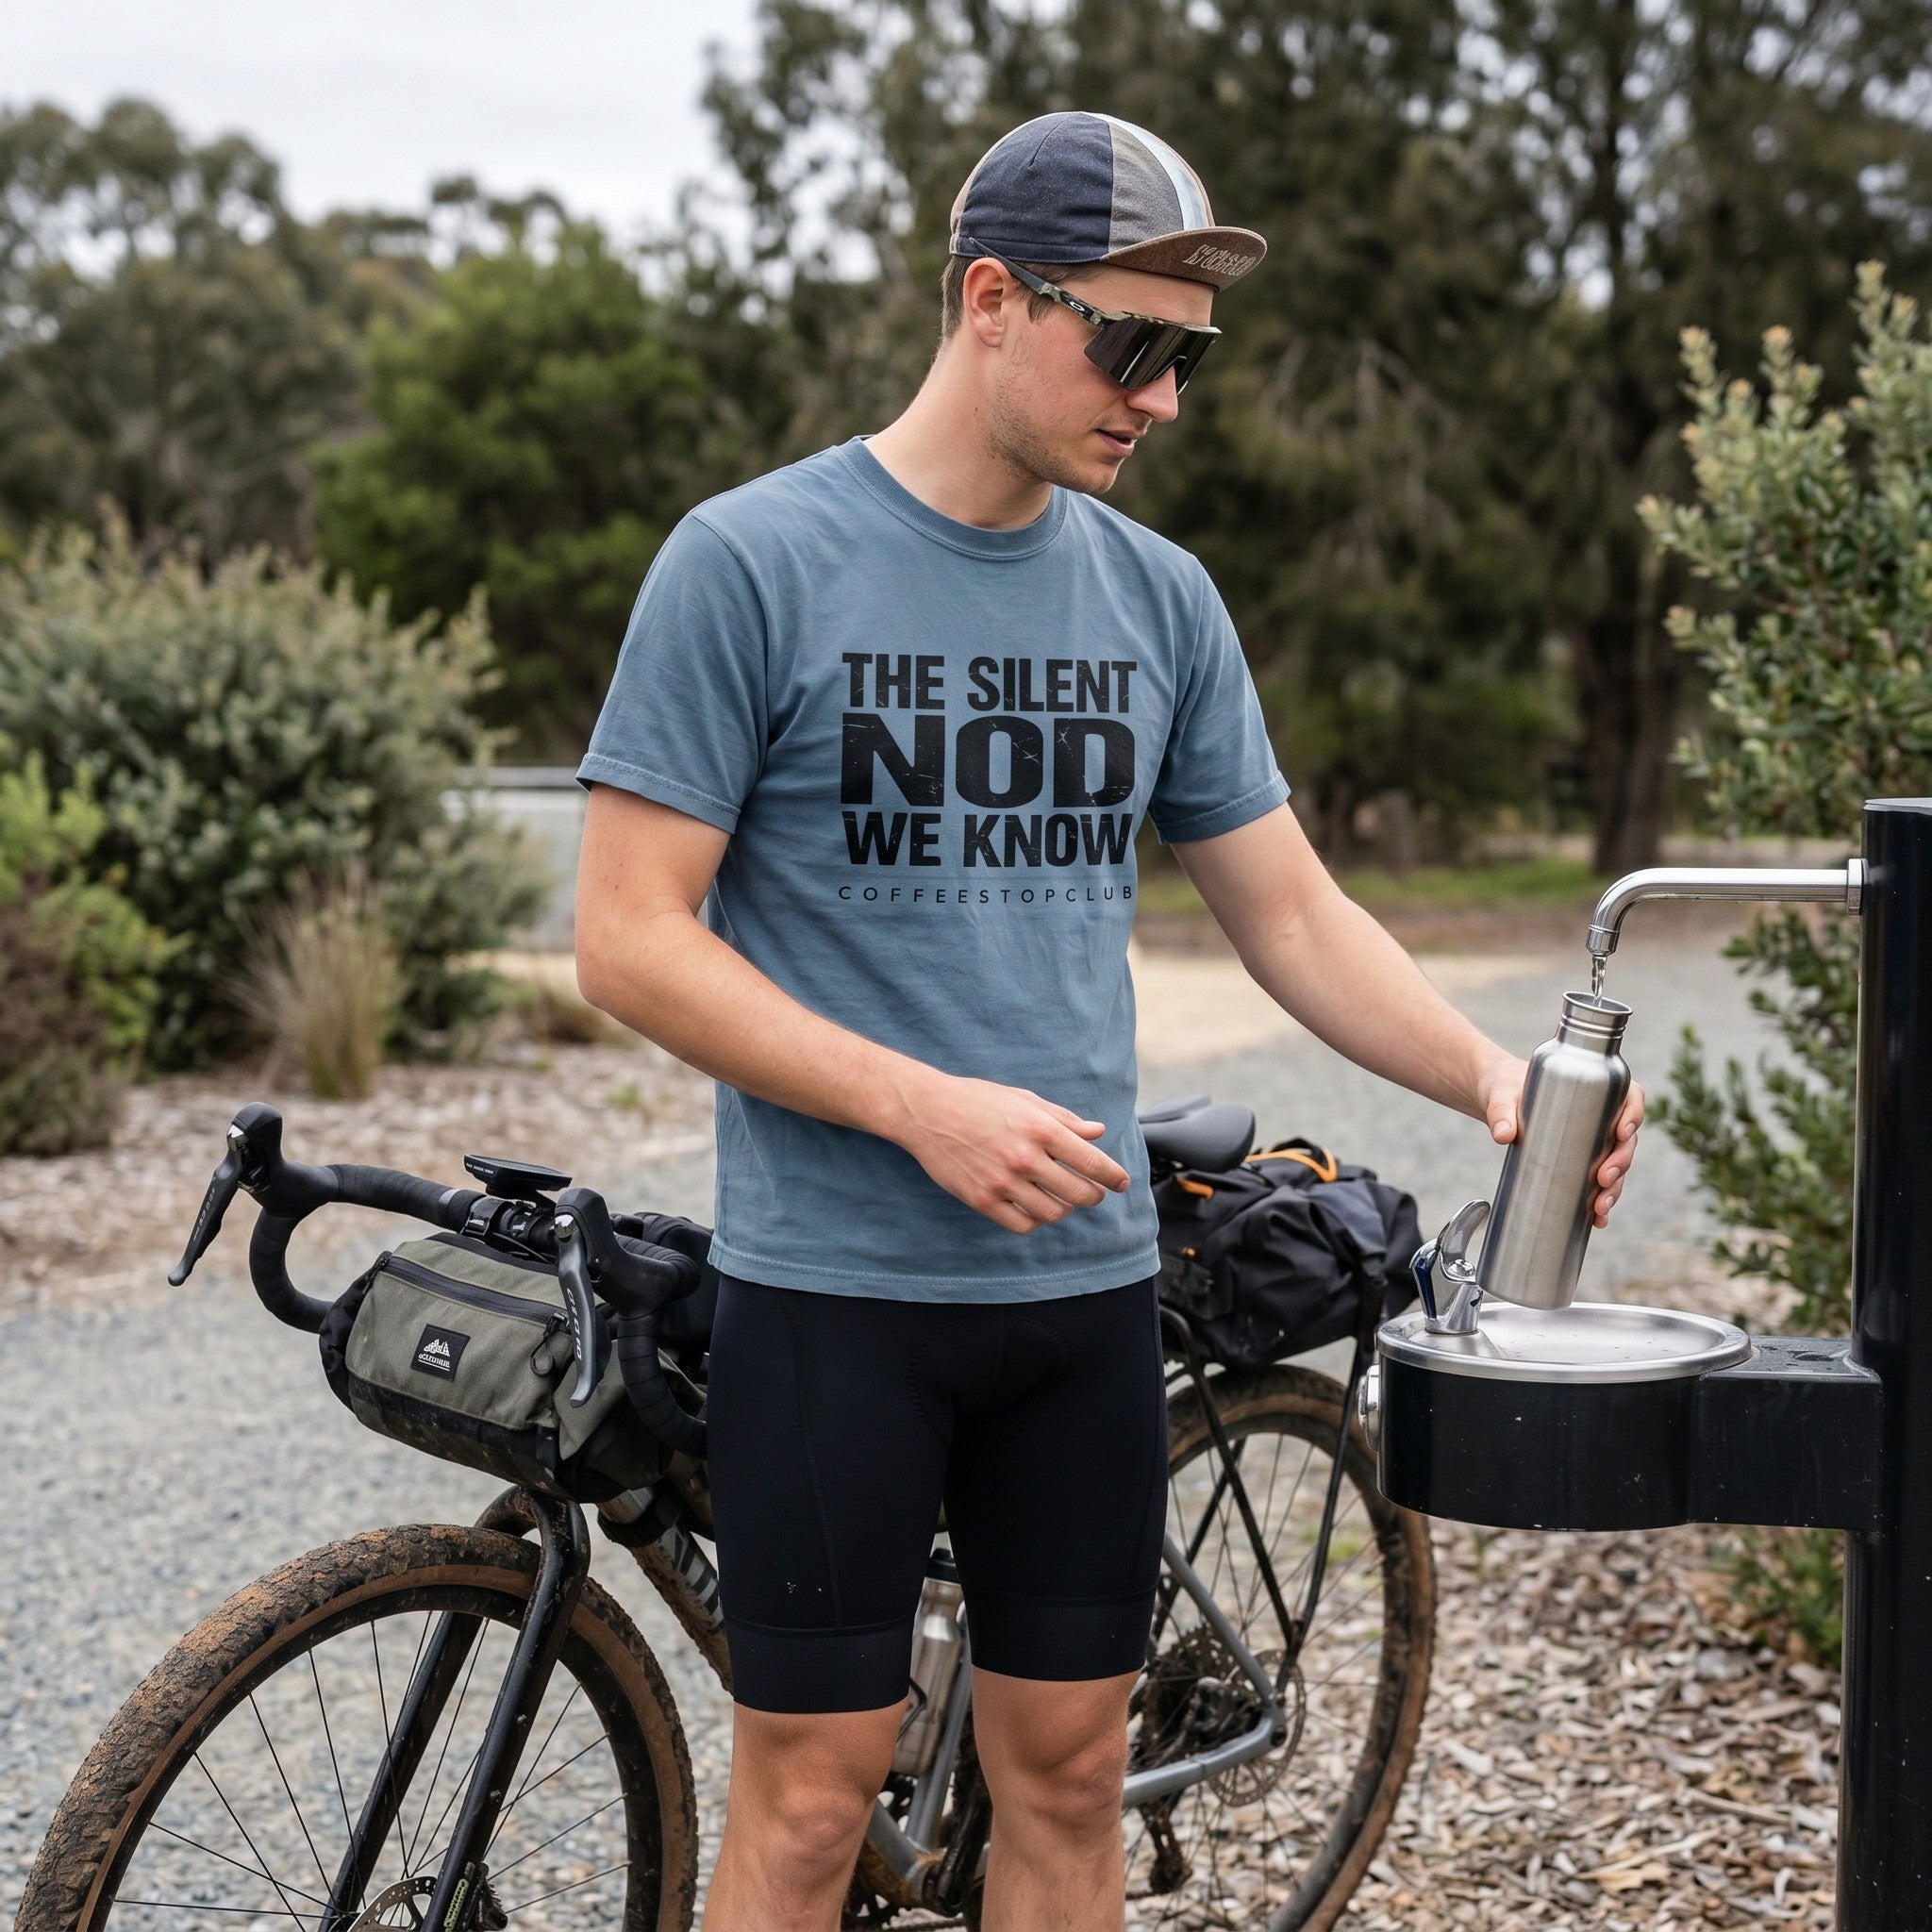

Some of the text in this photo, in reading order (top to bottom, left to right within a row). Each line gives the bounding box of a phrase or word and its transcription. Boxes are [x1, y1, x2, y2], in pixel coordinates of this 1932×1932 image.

[842, 653, 1138, 713] THE SILENT
[841, 712, 1135, 808] NOD
[841, 811, 1133, 867] WE KNOW
[839, 886, 1132, 904] COFFEESTOPCLUB
